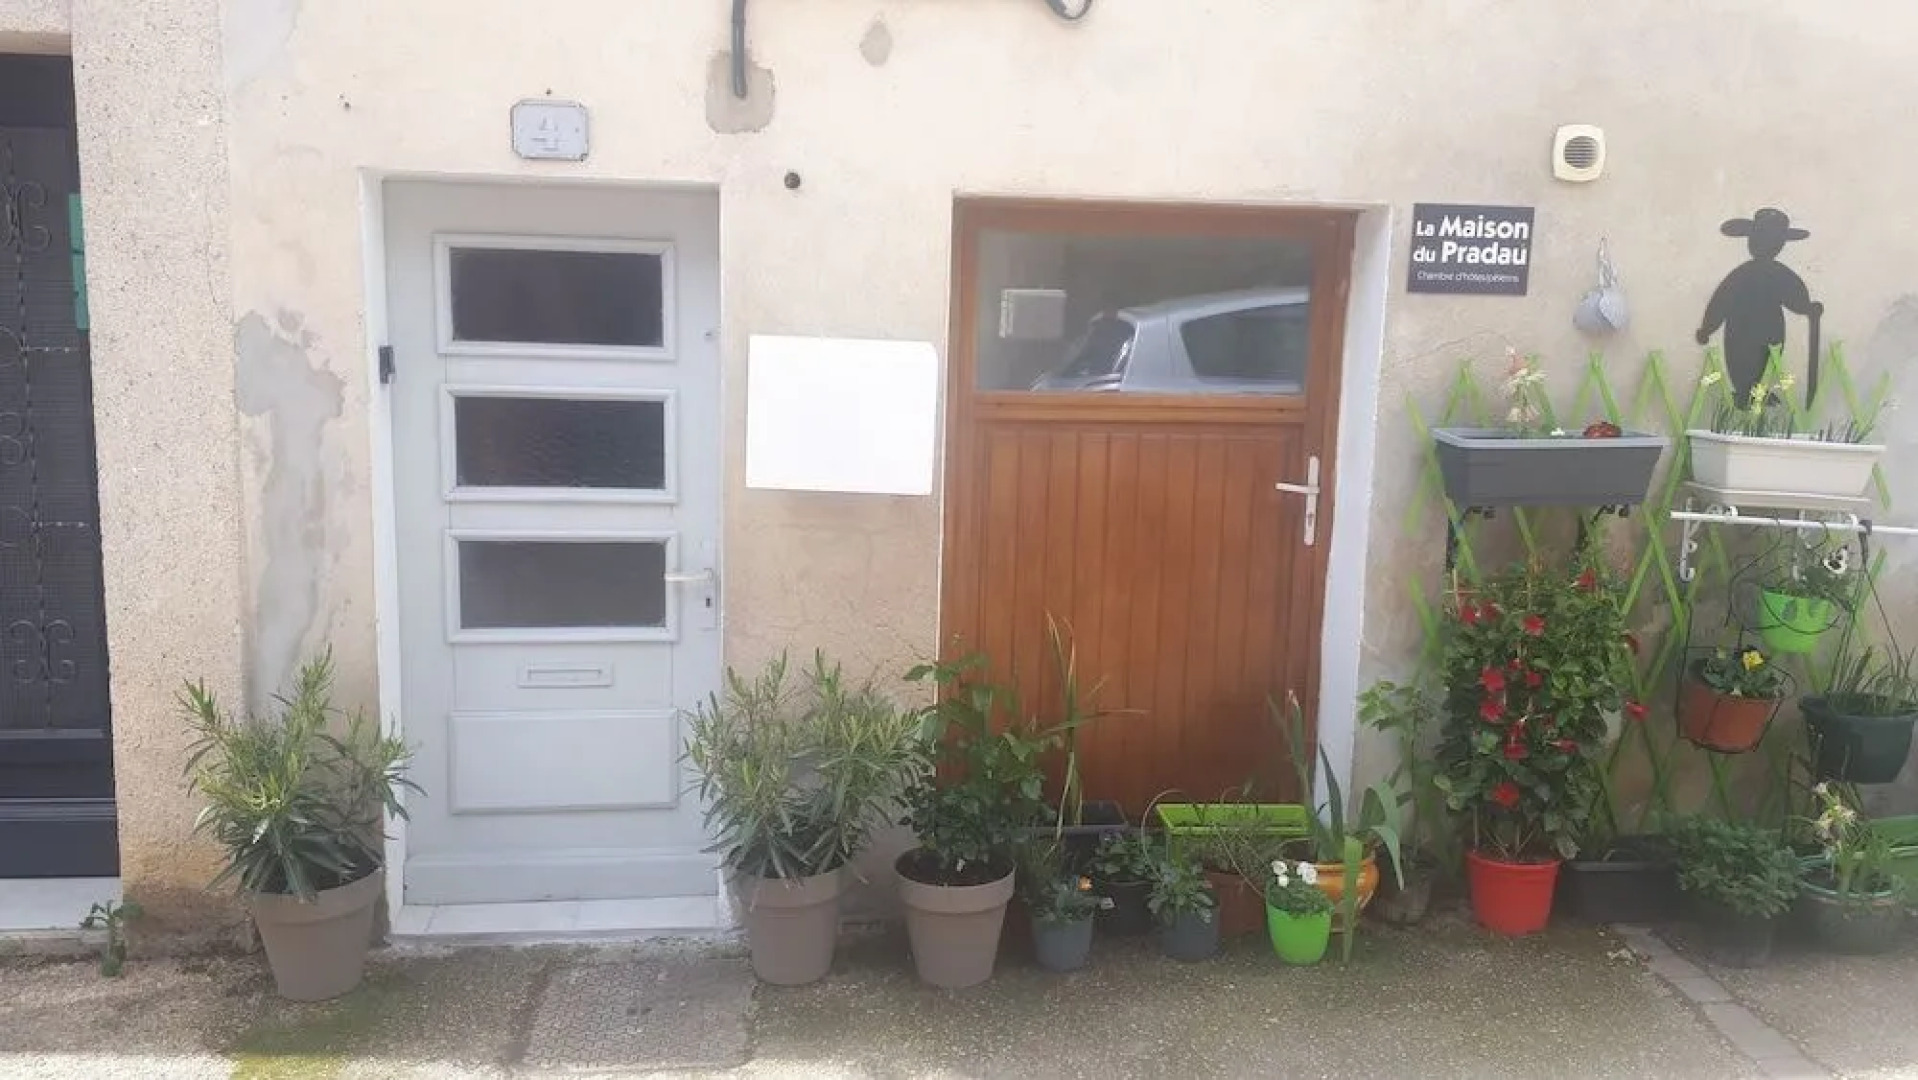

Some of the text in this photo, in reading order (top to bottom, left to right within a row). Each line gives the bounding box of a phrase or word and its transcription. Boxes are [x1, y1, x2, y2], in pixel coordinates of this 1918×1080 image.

[1416, 214, 1529, 239] La Maison
[1413, 245, 1436, 262] du
